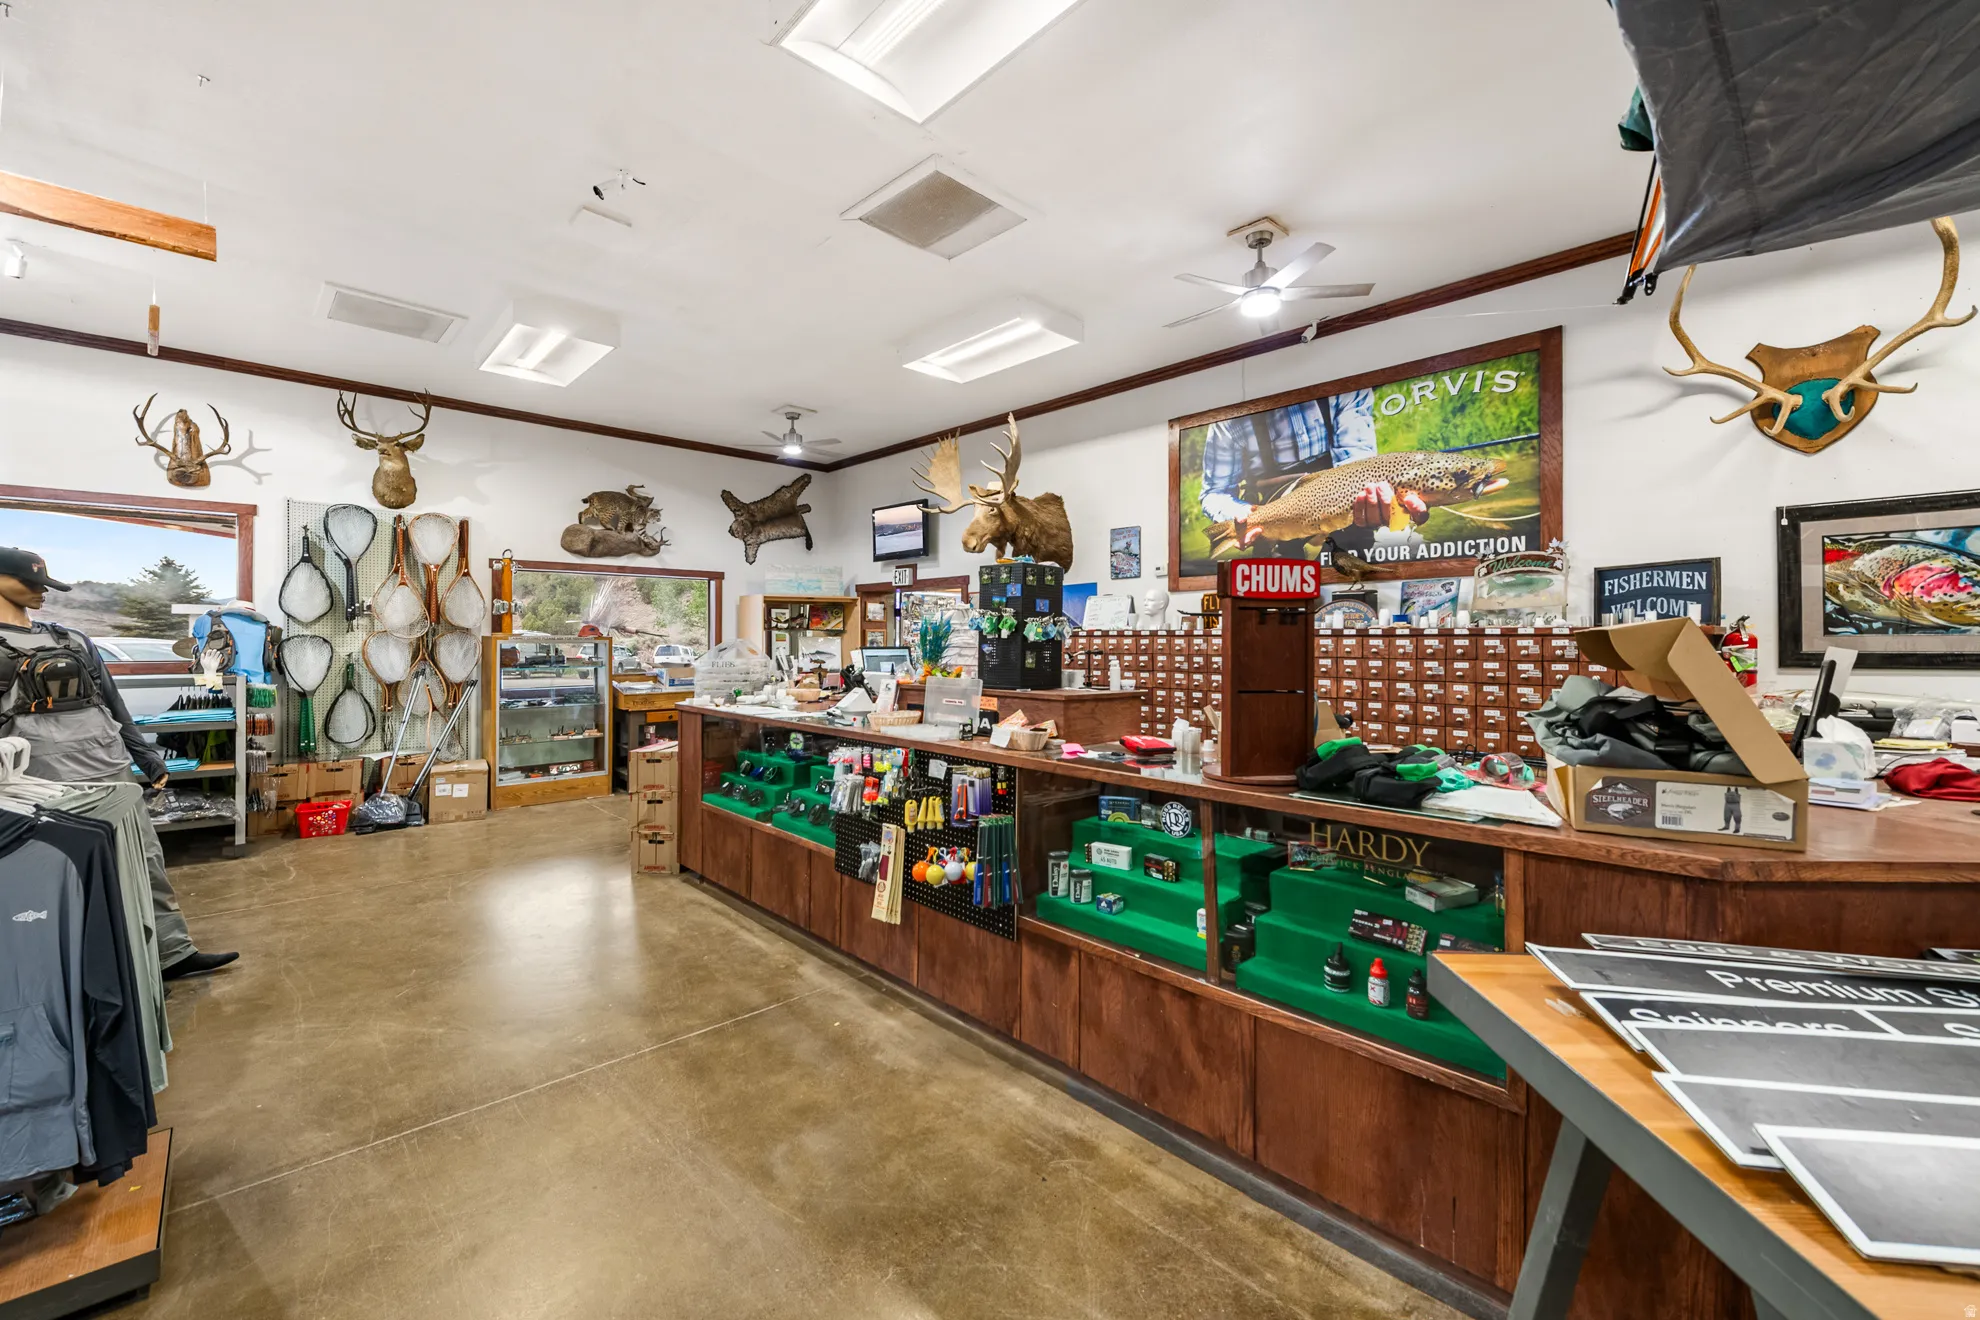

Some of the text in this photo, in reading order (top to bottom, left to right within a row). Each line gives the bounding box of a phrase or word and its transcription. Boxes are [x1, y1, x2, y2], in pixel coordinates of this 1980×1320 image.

[1381, 370, 1520, 416] ORVIS
[1363, 545, 1411, 563] YOUR
[1416, 535, 1526, 560] ADDICTION
[894, 569, 908, 585] EXIT
[1488, 555, 1554, 572] Welcome
[1236, 563, 1316, 596] CHUMS
[1604, 570, 1708, 597] FISHERMEN
[1592, 794, 1649, 808] STEELHEADER
[1309, 821, 1431, 867] HARDY
[1052, 865, 1061, 889] Daisy
[1635, 938, 1755, 957] Eggs
[1705, 969, 1933, 1006] Premium
